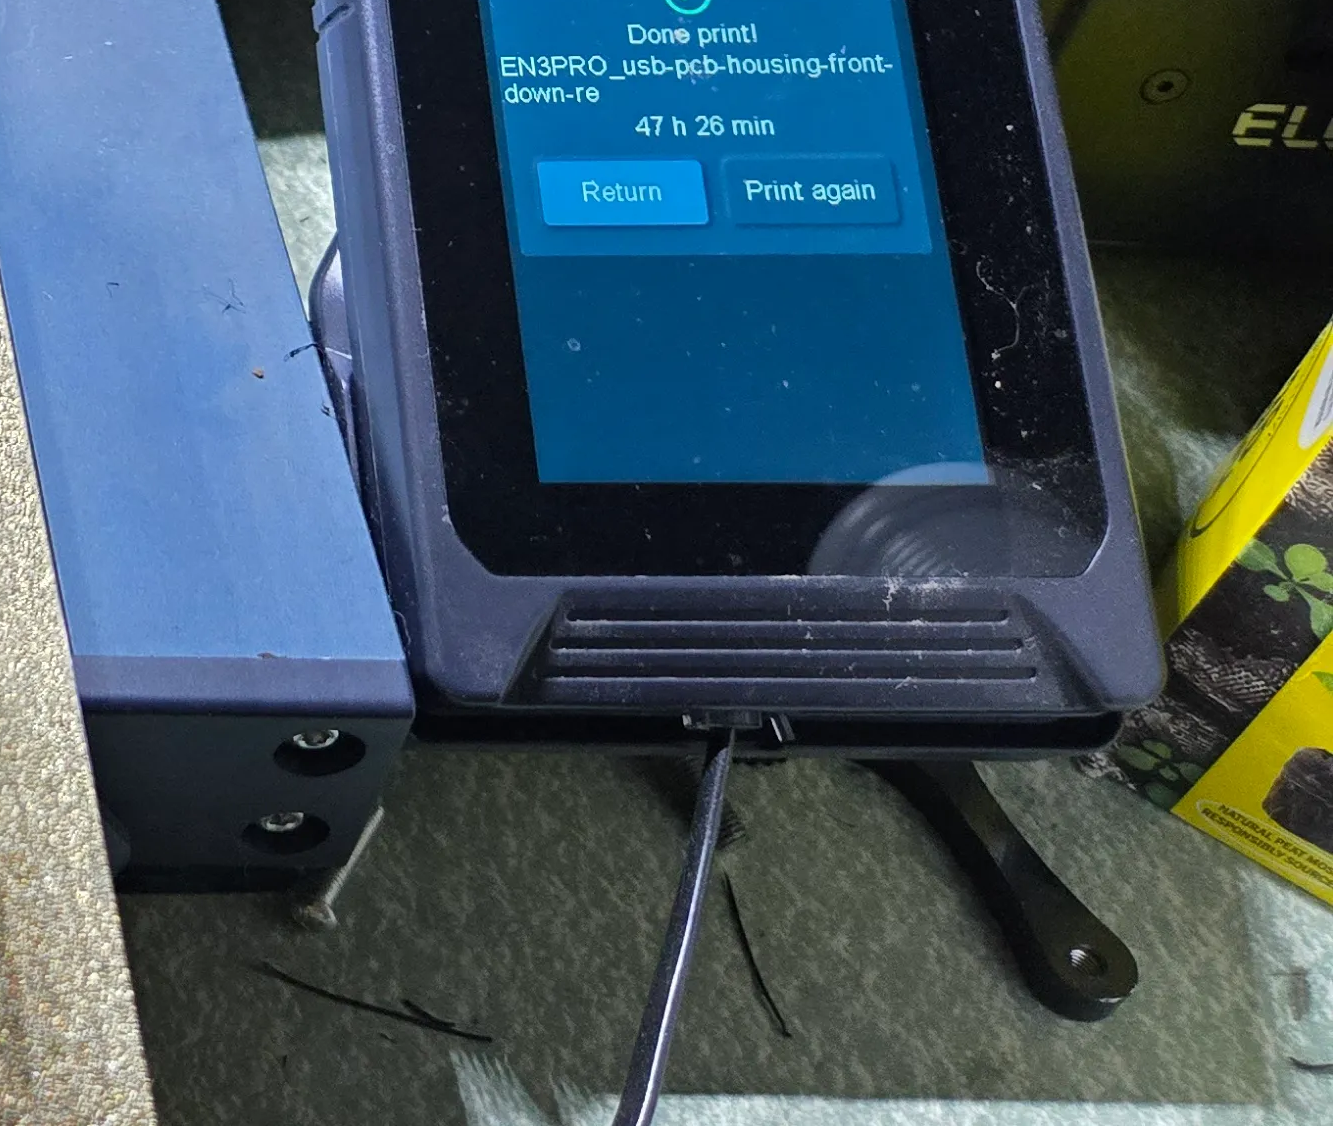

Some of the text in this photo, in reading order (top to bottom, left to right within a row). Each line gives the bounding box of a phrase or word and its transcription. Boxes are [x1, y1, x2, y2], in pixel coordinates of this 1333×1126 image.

[627, 22, 758, 49] Done print!
[500, 52, 894, 81] EN3PRO_usb-pcb-housing-front-
[504, 82, 600, 104] down-re
[634, 115, 775, 137] 47 h 26 min
[581, 179, 663, 203] Return
[743, 178, 877, 205] Print again
[1200, 807, 1287, 859] RESPONSIBLY
[1218, 804, 1274, 842] NATURAL
[1273, 837, 1308, 858] PEAT
